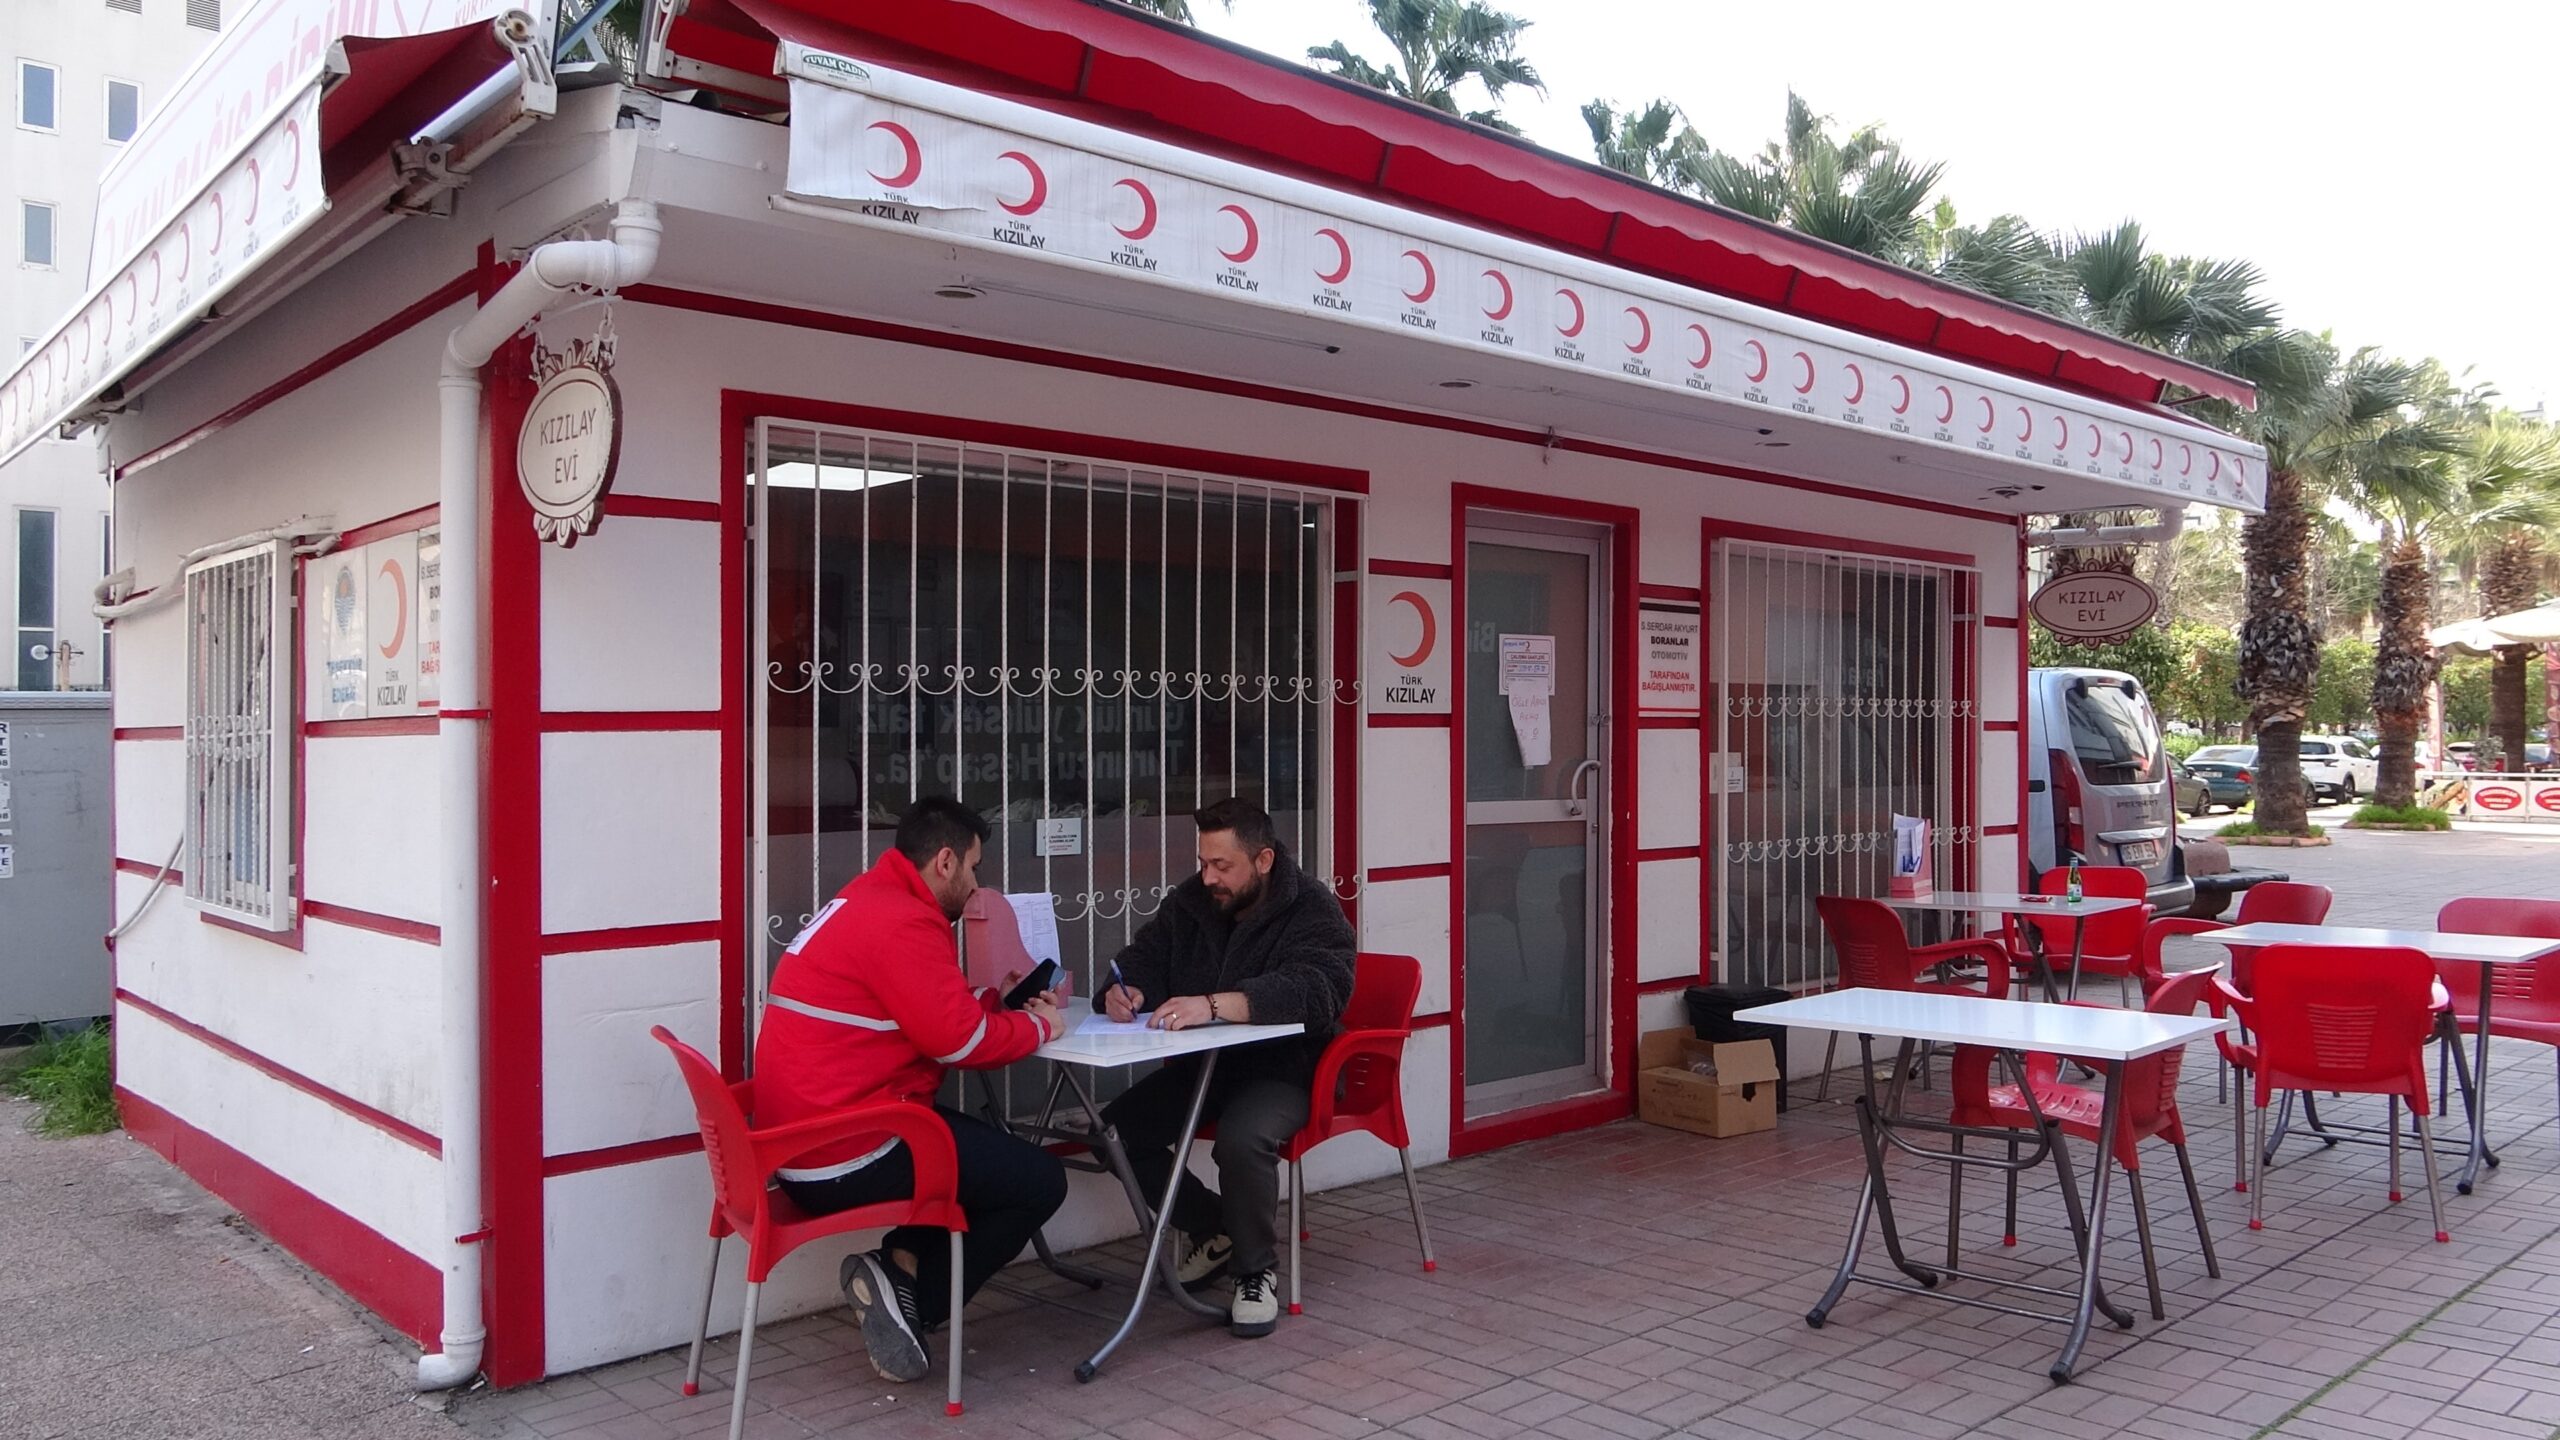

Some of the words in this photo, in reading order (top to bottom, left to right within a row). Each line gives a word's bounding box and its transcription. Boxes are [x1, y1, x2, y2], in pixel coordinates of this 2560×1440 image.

[862, 203, 920, 225] KIZILAY
[1008, 220, 1031, 232] TÜRK
[993, 227, 1046, 249] KIZILAY
[1124, 244, 1145, 255] TÜRK
[1111, 251, 1157, 271] KIZILAY
[1228, 267, 1247, 277] TÜRK
[1216, 273, 1259, 292] KIZILAY
[1324, 287, 1341, 297] TÜRK
[1313, 294, 1352, 312] KIZILAY
[1411, 306, 1426, 316] TÜRK
[1401, 313, 1437, 330] KIZILAY
[1490, 324, 1505, 333] TÜRK
[1481, 330, 1514, 346] KIZILAY
[1554, 346, 1585, 362] KIZILAY
[1623, 362, 1651, 377] KIZILAY
[1686, 378, 1712, 392] KIZILAY
[540, 408, 597, 447] KIZILAY
[555, 448, 579, 484] EVİ
[2058, 590, 2125, 604] KIZILAY
[2078, 607, 2106, 622] EVİ
[1651, 636, 1689, 646] BORANLAR
[385, 669, 399, 682] TÜRK
[1401, 674, 1423, 685] TÜRK
[1650, 670, 1690, 680] TARAFINDAN
[377, 685, 408, 707] KIZILAY
[1386, 687, 1436, 703] KIZILAY
